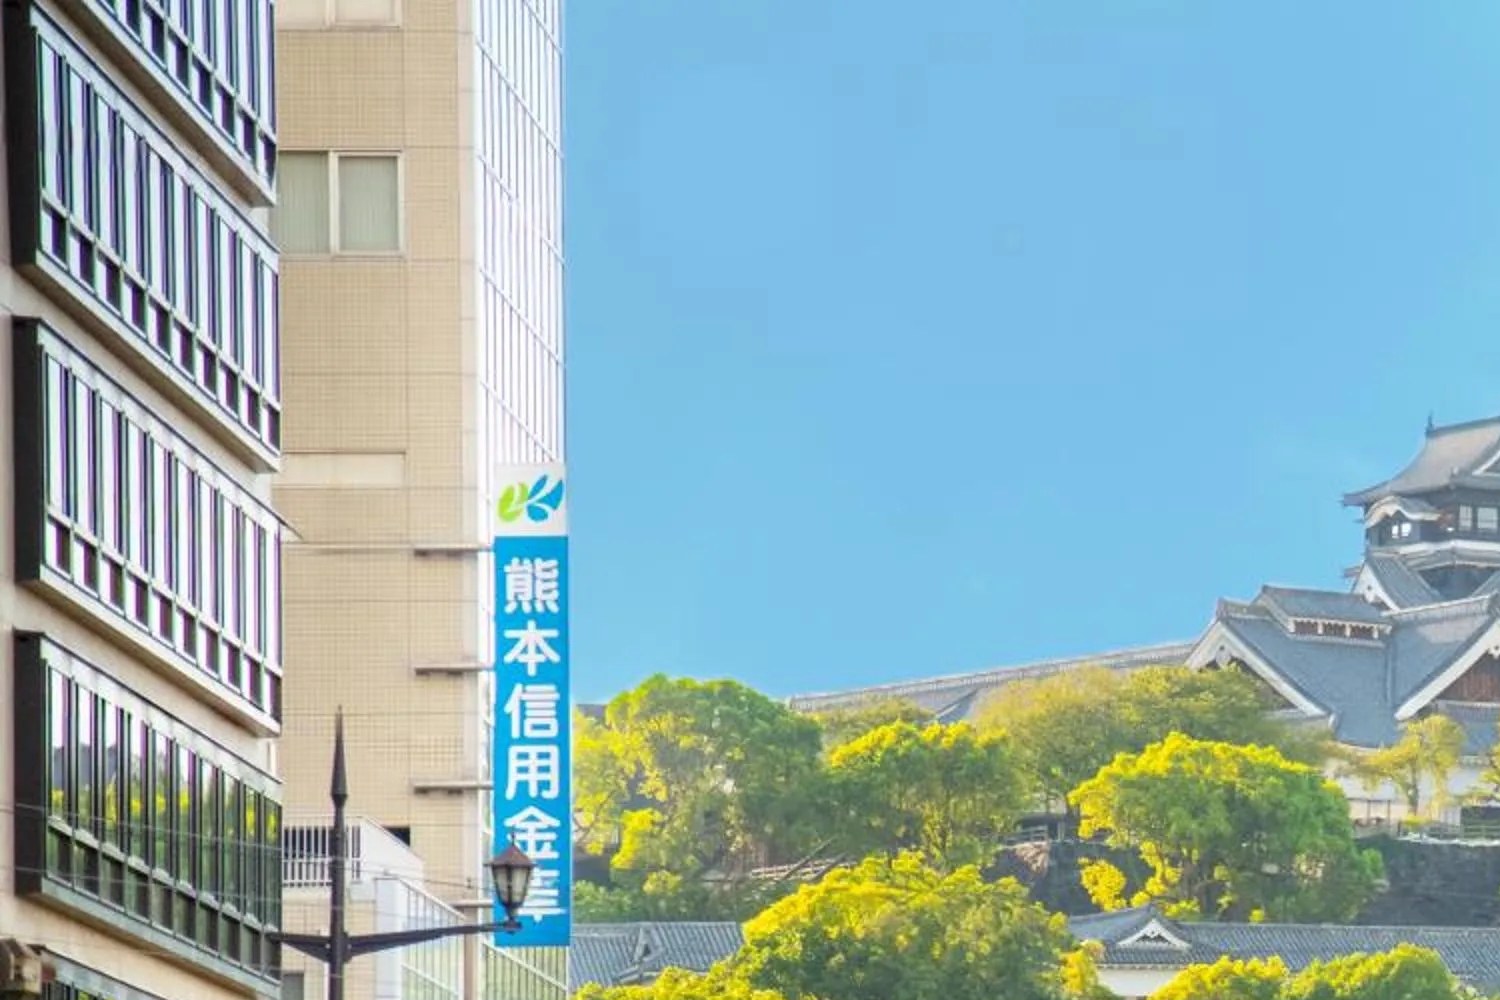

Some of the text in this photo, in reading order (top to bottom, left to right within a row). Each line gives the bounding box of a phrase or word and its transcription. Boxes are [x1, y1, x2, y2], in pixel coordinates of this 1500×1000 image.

[502, 556, 567, 921] 熊本信用金庫
